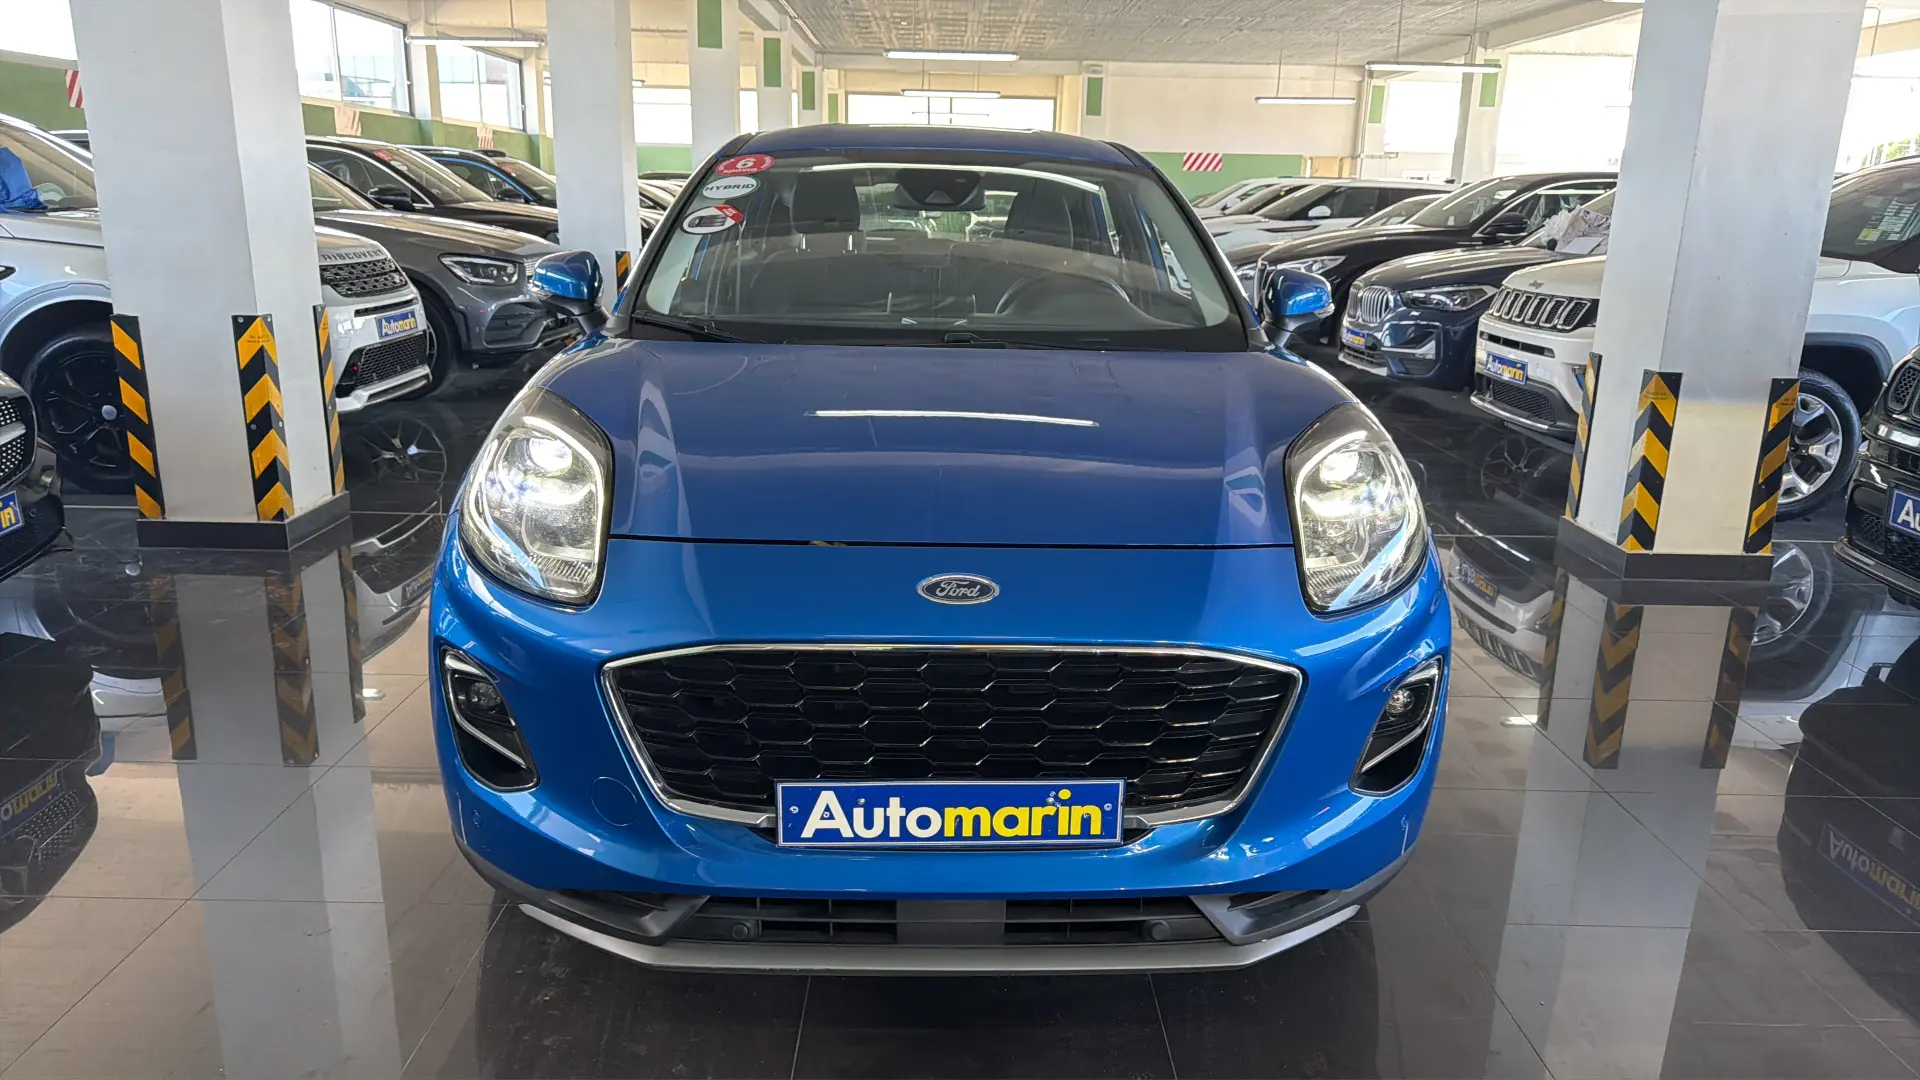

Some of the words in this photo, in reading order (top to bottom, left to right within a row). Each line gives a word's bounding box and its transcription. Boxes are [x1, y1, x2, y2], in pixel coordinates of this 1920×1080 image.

[736, 157, 756, 169] 6
[704, 183, 755, 192] HYBRID
[935, 580, 981, 597] Ford
[800, 788, 1102, 838] Automarin
